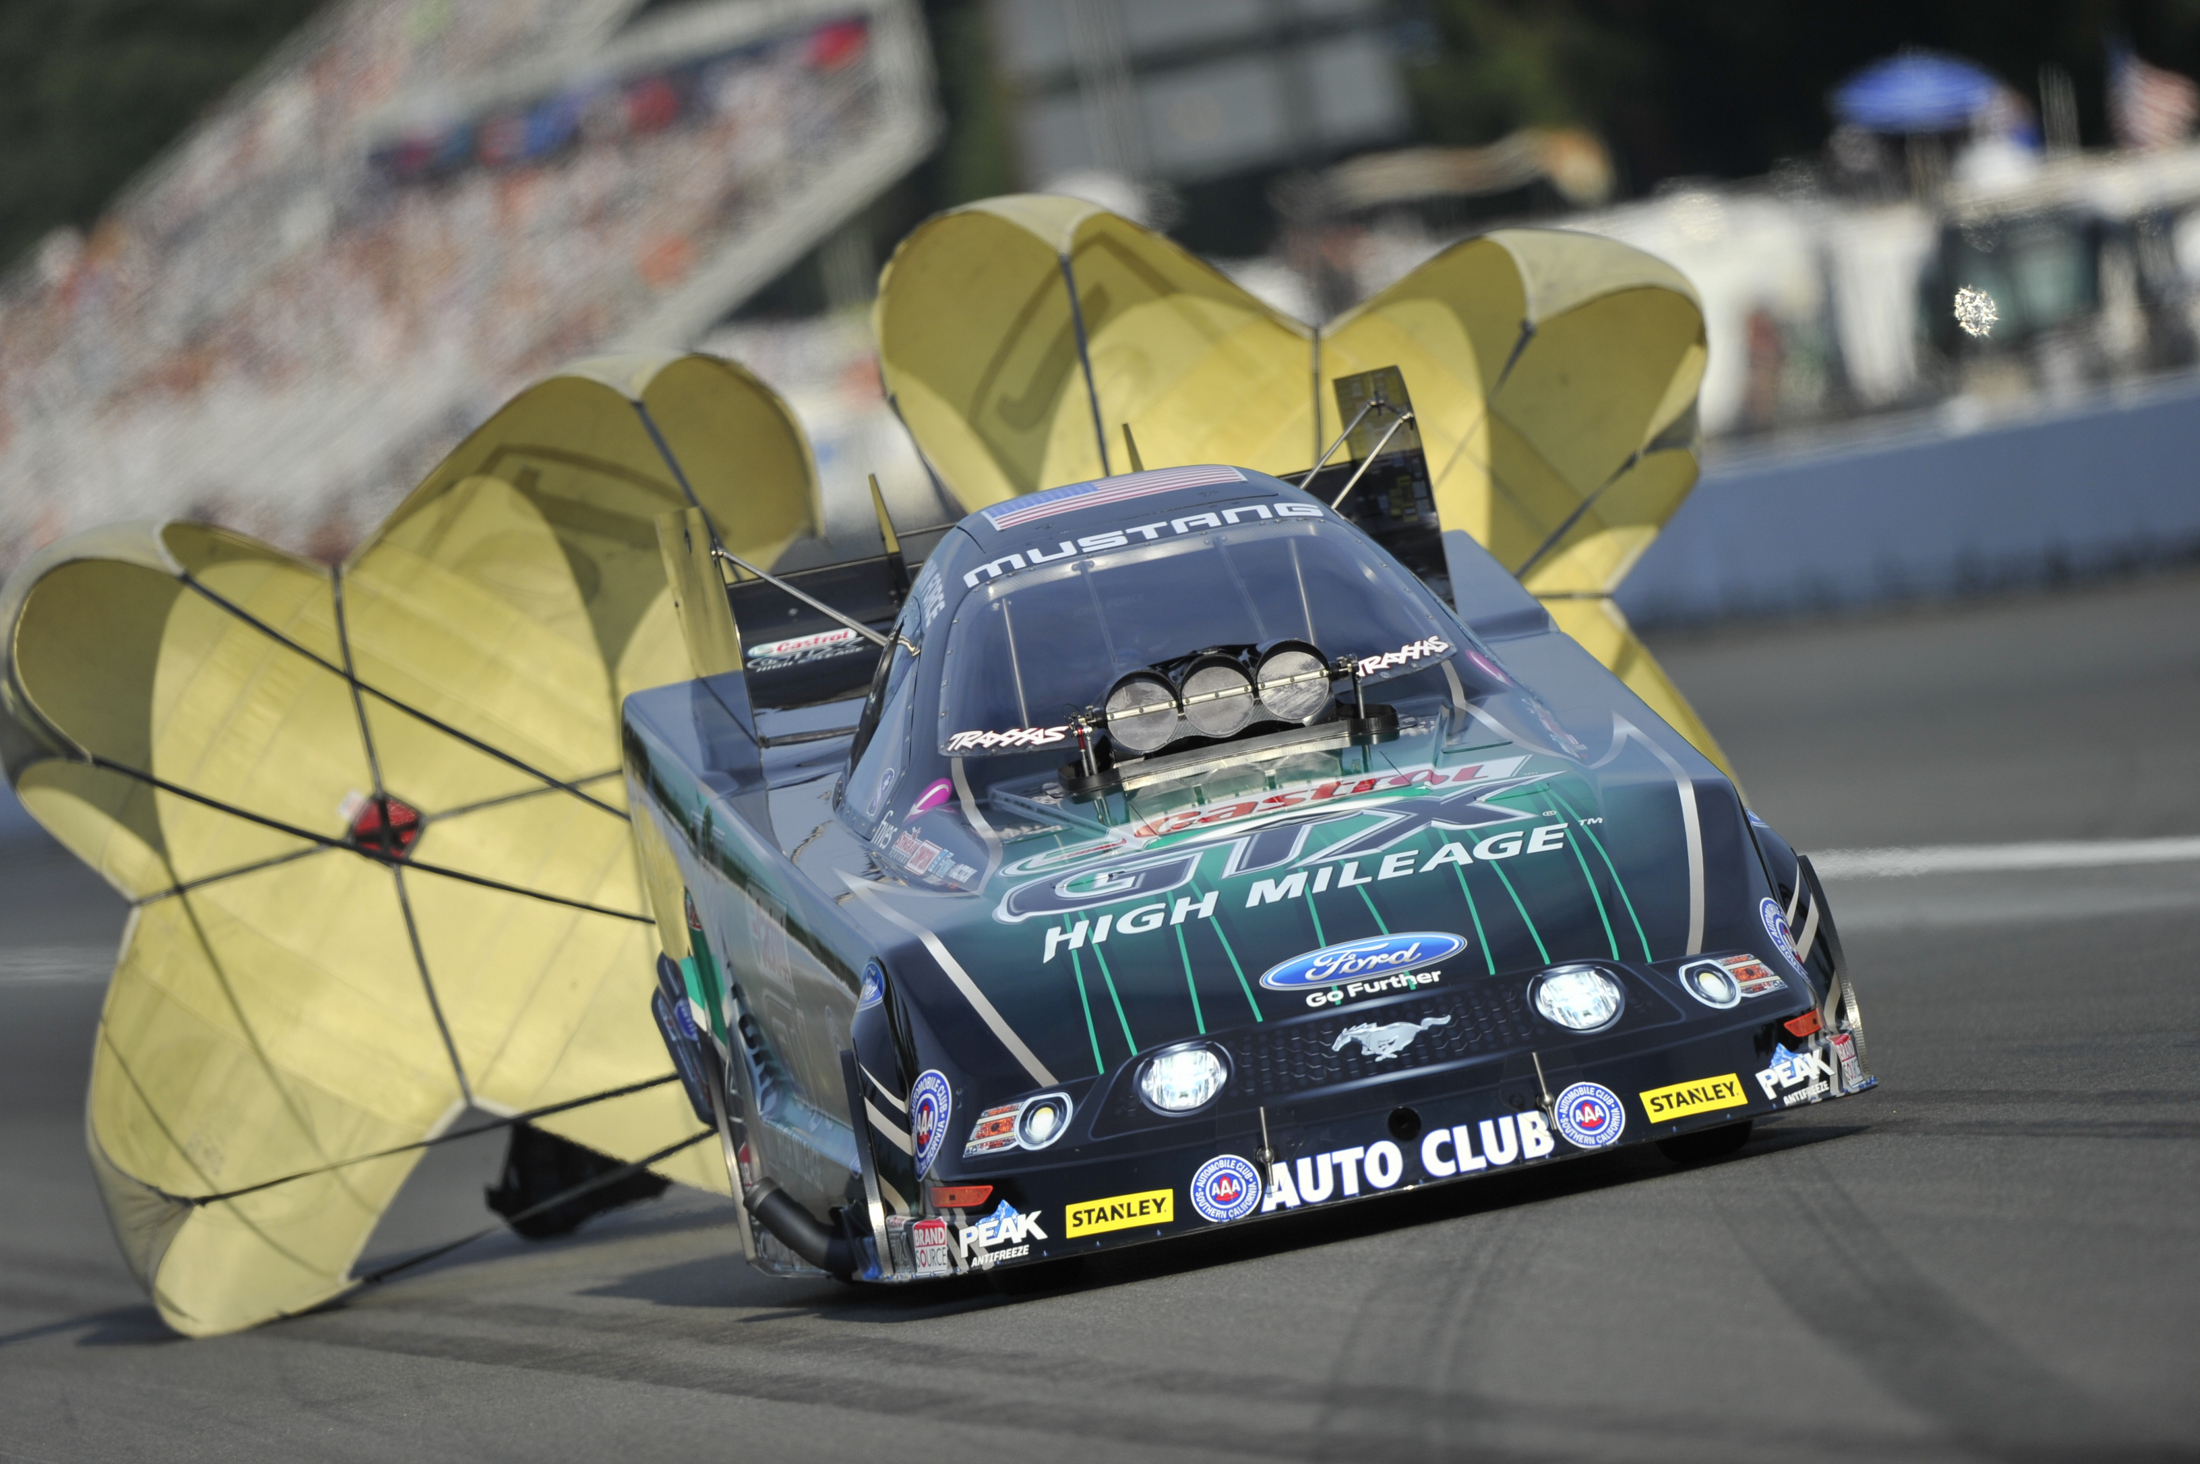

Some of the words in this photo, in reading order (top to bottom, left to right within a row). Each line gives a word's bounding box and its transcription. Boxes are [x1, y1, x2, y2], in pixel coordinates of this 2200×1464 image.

[963, 503, 1324, 588] MUSTANG
[777, 631, 849, 652] Castrol
[1356, 635, 1449, 677] TRAXXAS
[947, 725, 1069, 752] TRAXXAS
[1134, 764, 1488, 837] Castrol
[993, 770, 1572, 924] GTX
[1042, 891, 1219, 964] HIGH
[1245, 823, 1568, 908] MILEAGE
[1305, 942, 1422, 981] Ford
[1306, 990, 1344, 1008] Go
[1346, 970, 1441, 998] Further
[1755, 1050, 1836, 1100] PEAK
[936, 1085, 948, 1113] CLUB
[1559, 1086, 1595, 1114] AUTOMOBILE
[1595, 1090, 1615, 1106] CLUB
[1650, 1081, 1736, 1113] STANLEY
[1783, 1080, 1830, 1106] ANTIFREEZE
[917, 1109, 934, 1136] AAA
[1560, 1117, 1596, 1145] SOUTHERN
[1596, 1107, 1621, 1145] CALIFORNIA
[1575, 1105, 1604, 1123] AAA
[1196, 1159, 1236, 1188] AUTOMOBILE
[1236, 1162, 1254, 1180] CLUB
[1261, 1139, 1402, 1213] AUTO
[1421, 1110, 1555, 1178] CLUB
[1195, 1191, 1227, 1218] SOUTHERN
[1228, 1181, 1257, 1218] CALIFORNIA
[1212, 1179, 1241, 1197] AAA
[1072, 1197, 1167, 1228] STANLEY
[914, 1226, 946, 1247] BRAND
[959, 1210, 1048, 1259] PEAK
[914, 1246, 947, 1268] SOURCE
[971, 1244, 1030, 1268] ANTIFREEZE
